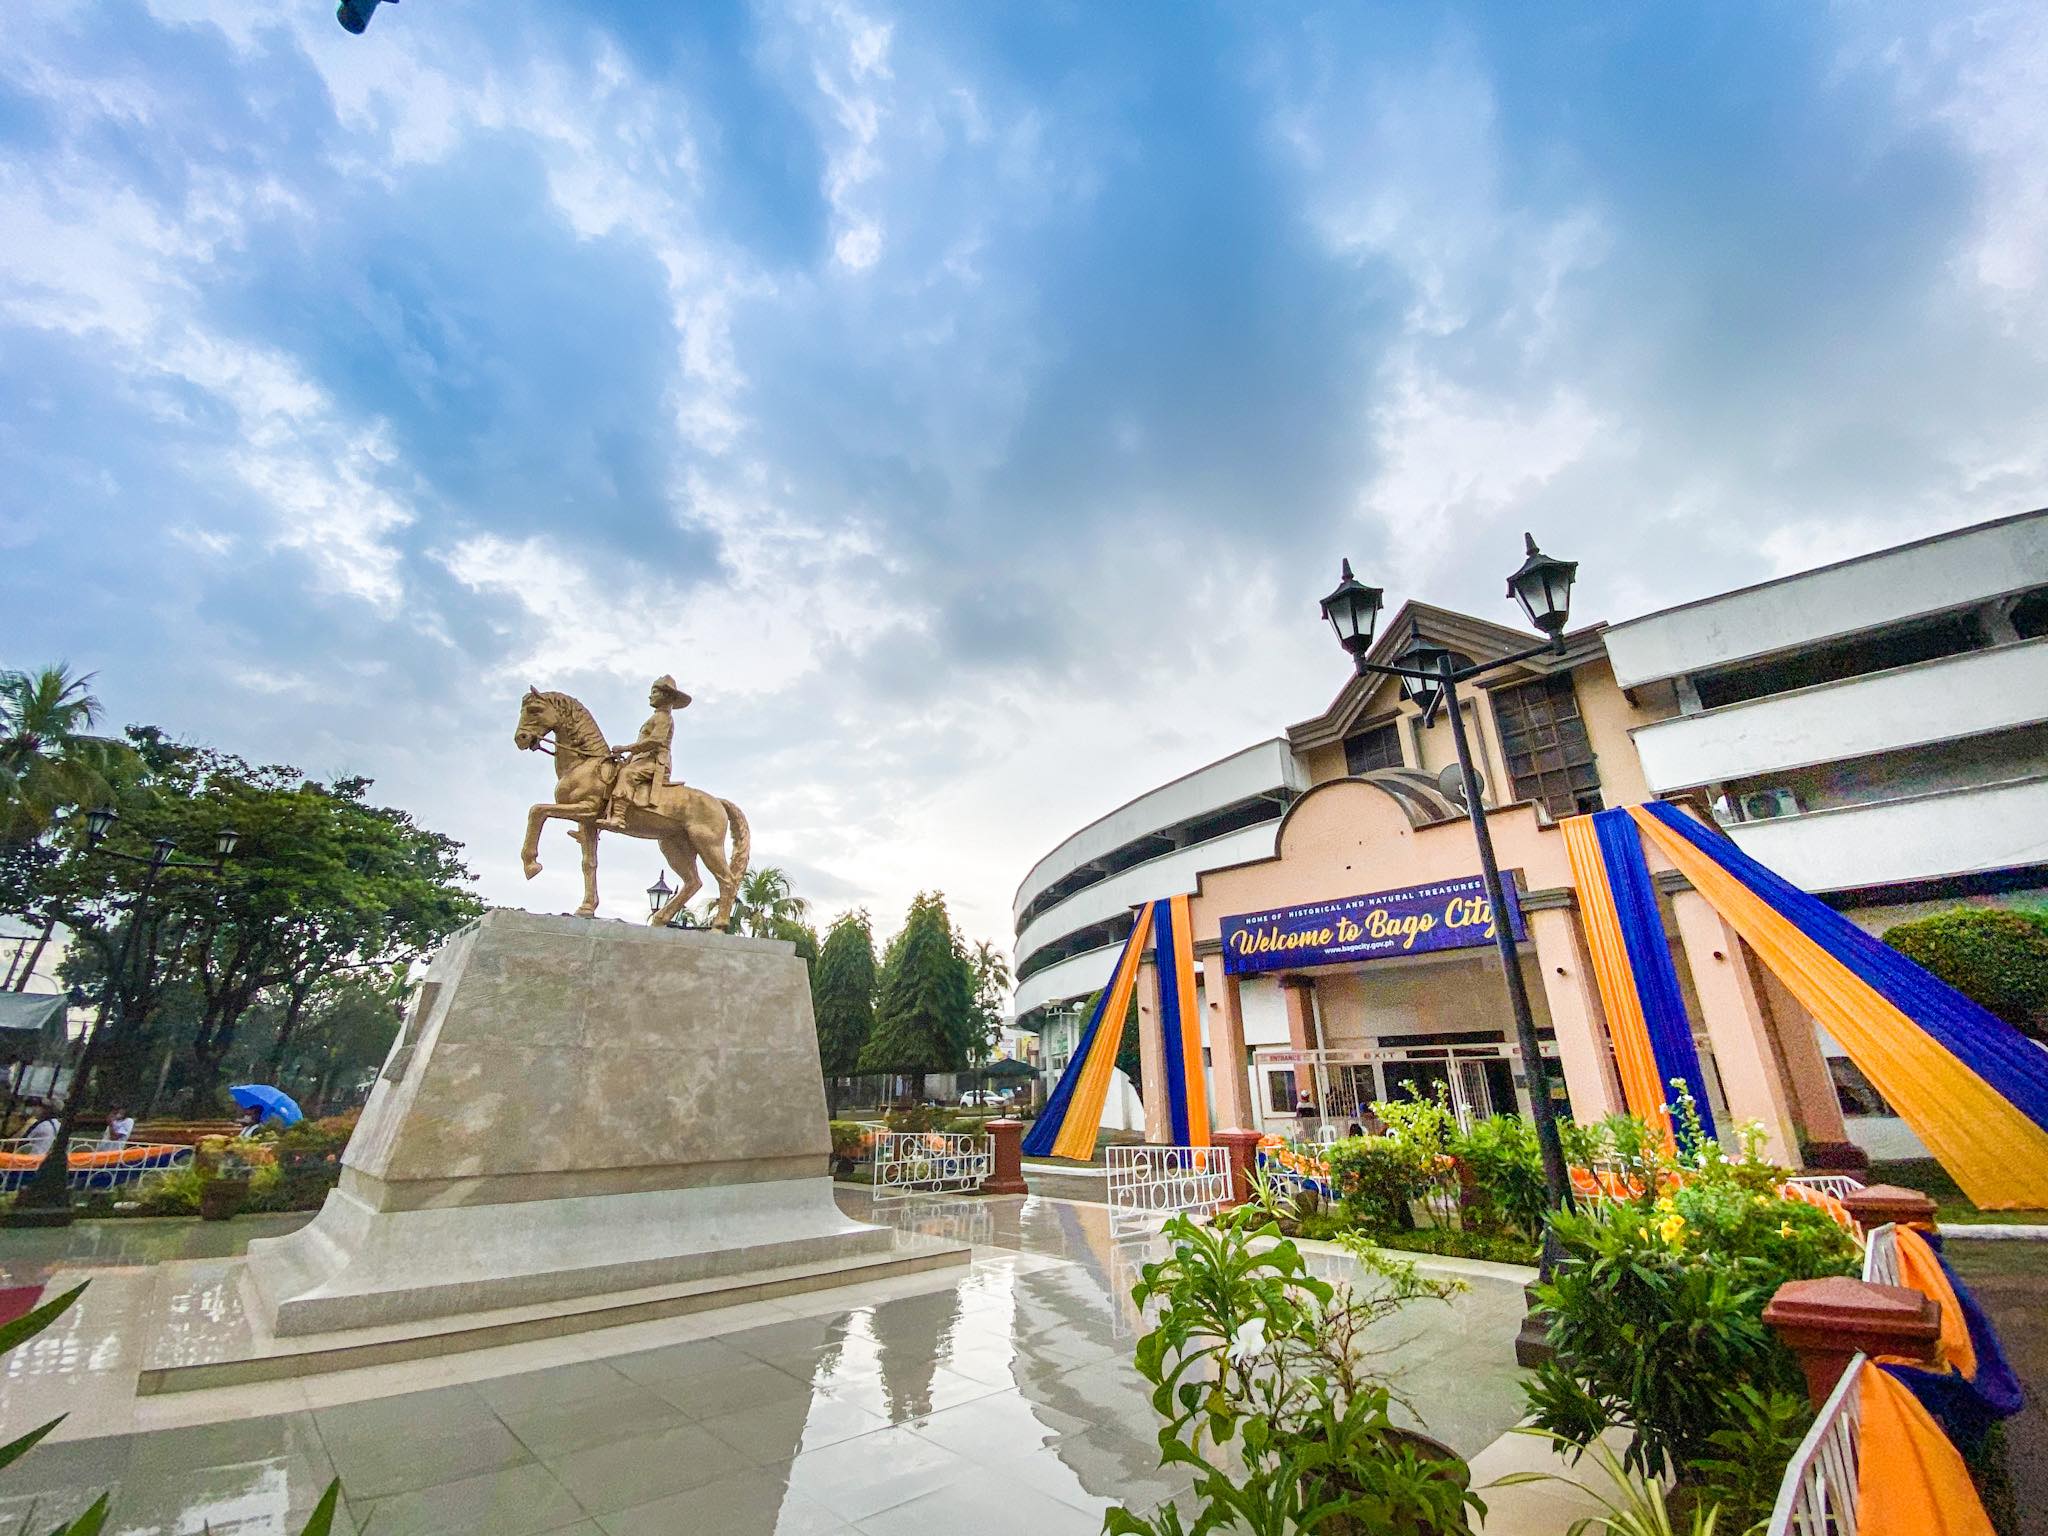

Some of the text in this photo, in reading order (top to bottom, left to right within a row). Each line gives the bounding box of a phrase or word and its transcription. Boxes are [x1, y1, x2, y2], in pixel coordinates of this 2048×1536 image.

[1245, 880, 1481, 925] HOME OF HISTORICAL AND NATURAL TREASURES
[1230, 895, 1495, 955] Welcome to Bago City
[1324, 939, 1394, 954] www.bagocity.gov.ph
[1513, 1045, 1549, 1055] ET
[1269, 1054, 1301, 1062] ENTRANCE
